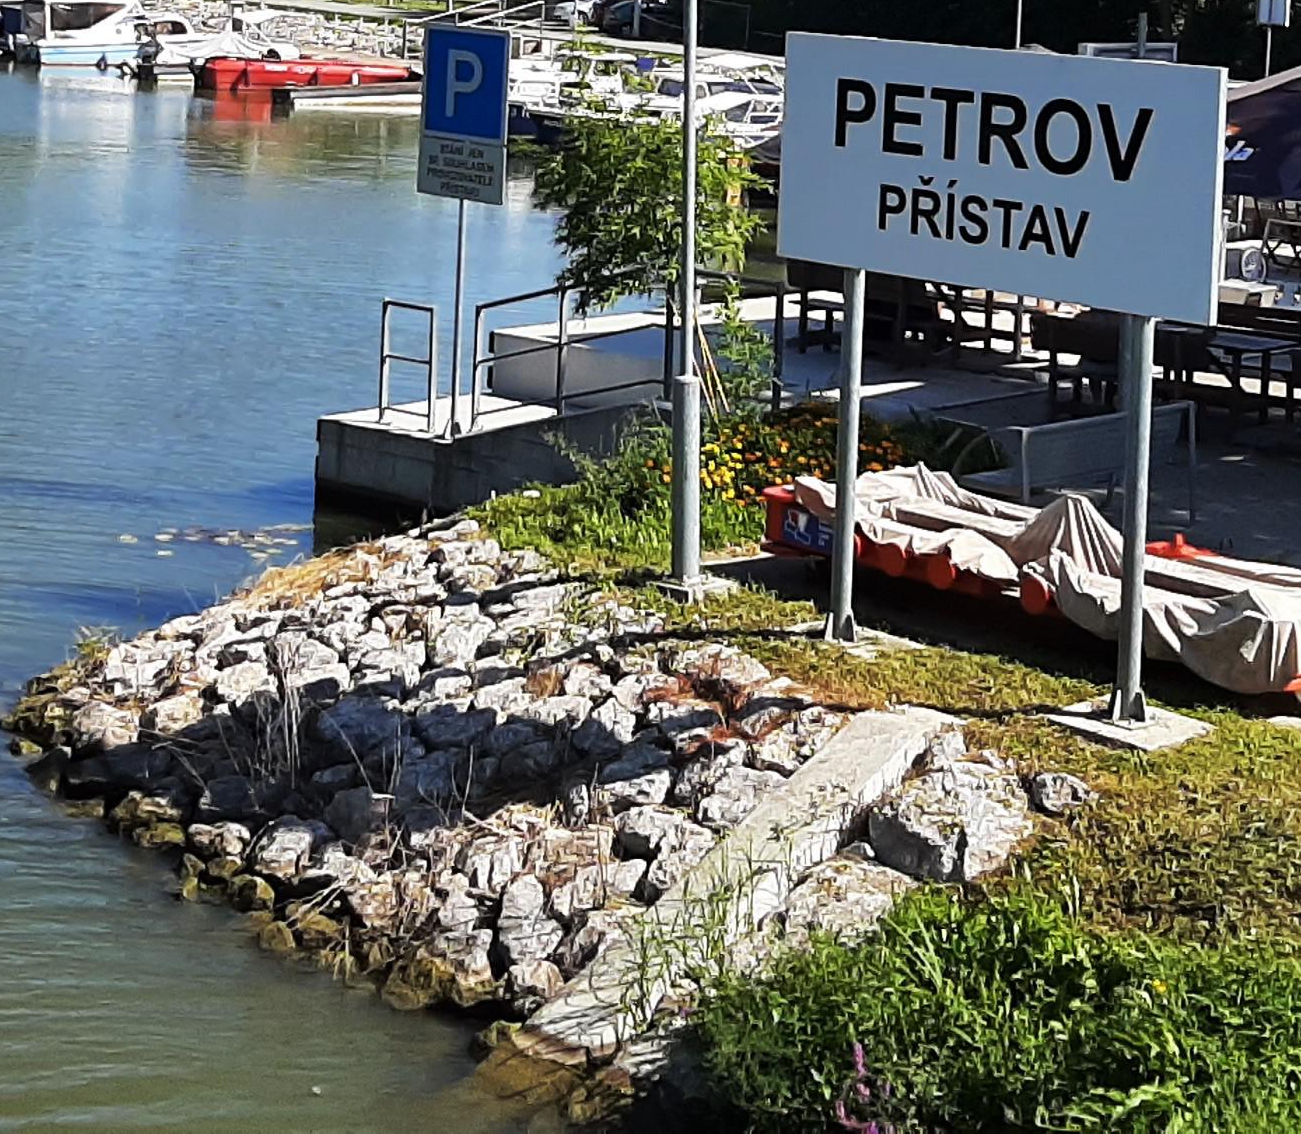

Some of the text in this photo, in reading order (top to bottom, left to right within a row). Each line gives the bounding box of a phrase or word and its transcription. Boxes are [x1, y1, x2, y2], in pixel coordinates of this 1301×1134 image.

[446, 49, 482, 117] P
[834, 78, 1154, 182] PETROV
[878, 174, 1091, 259] PŘÍSTAV
